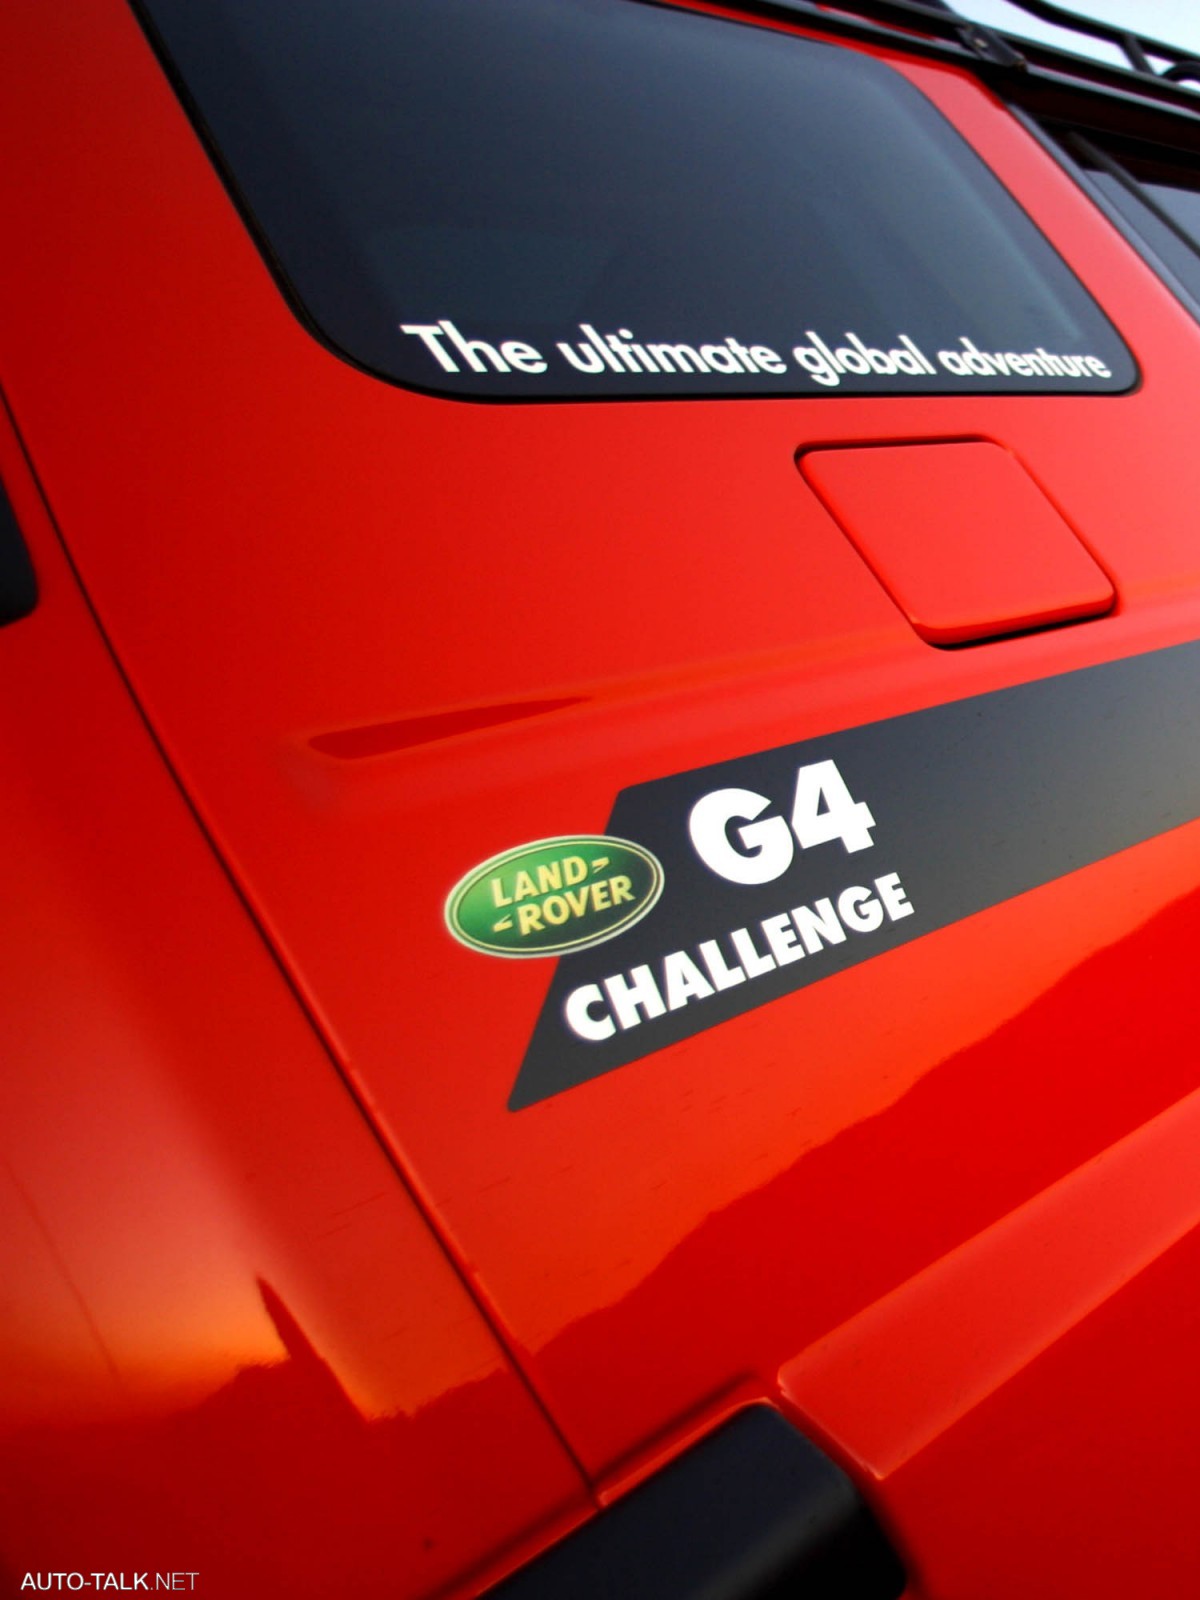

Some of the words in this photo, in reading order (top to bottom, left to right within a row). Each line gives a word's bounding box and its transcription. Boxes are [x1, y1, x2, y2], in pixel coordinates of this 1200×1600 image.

[401, 320, 547, 374] The
[557, 324, 787, 375] ultimate
[793, 330, 936, 386] global
[937, 337, 1112, 379] adventure
[688, 759, 876, 885] G4
[564, 872, 915, 1041] CHALLENGE
